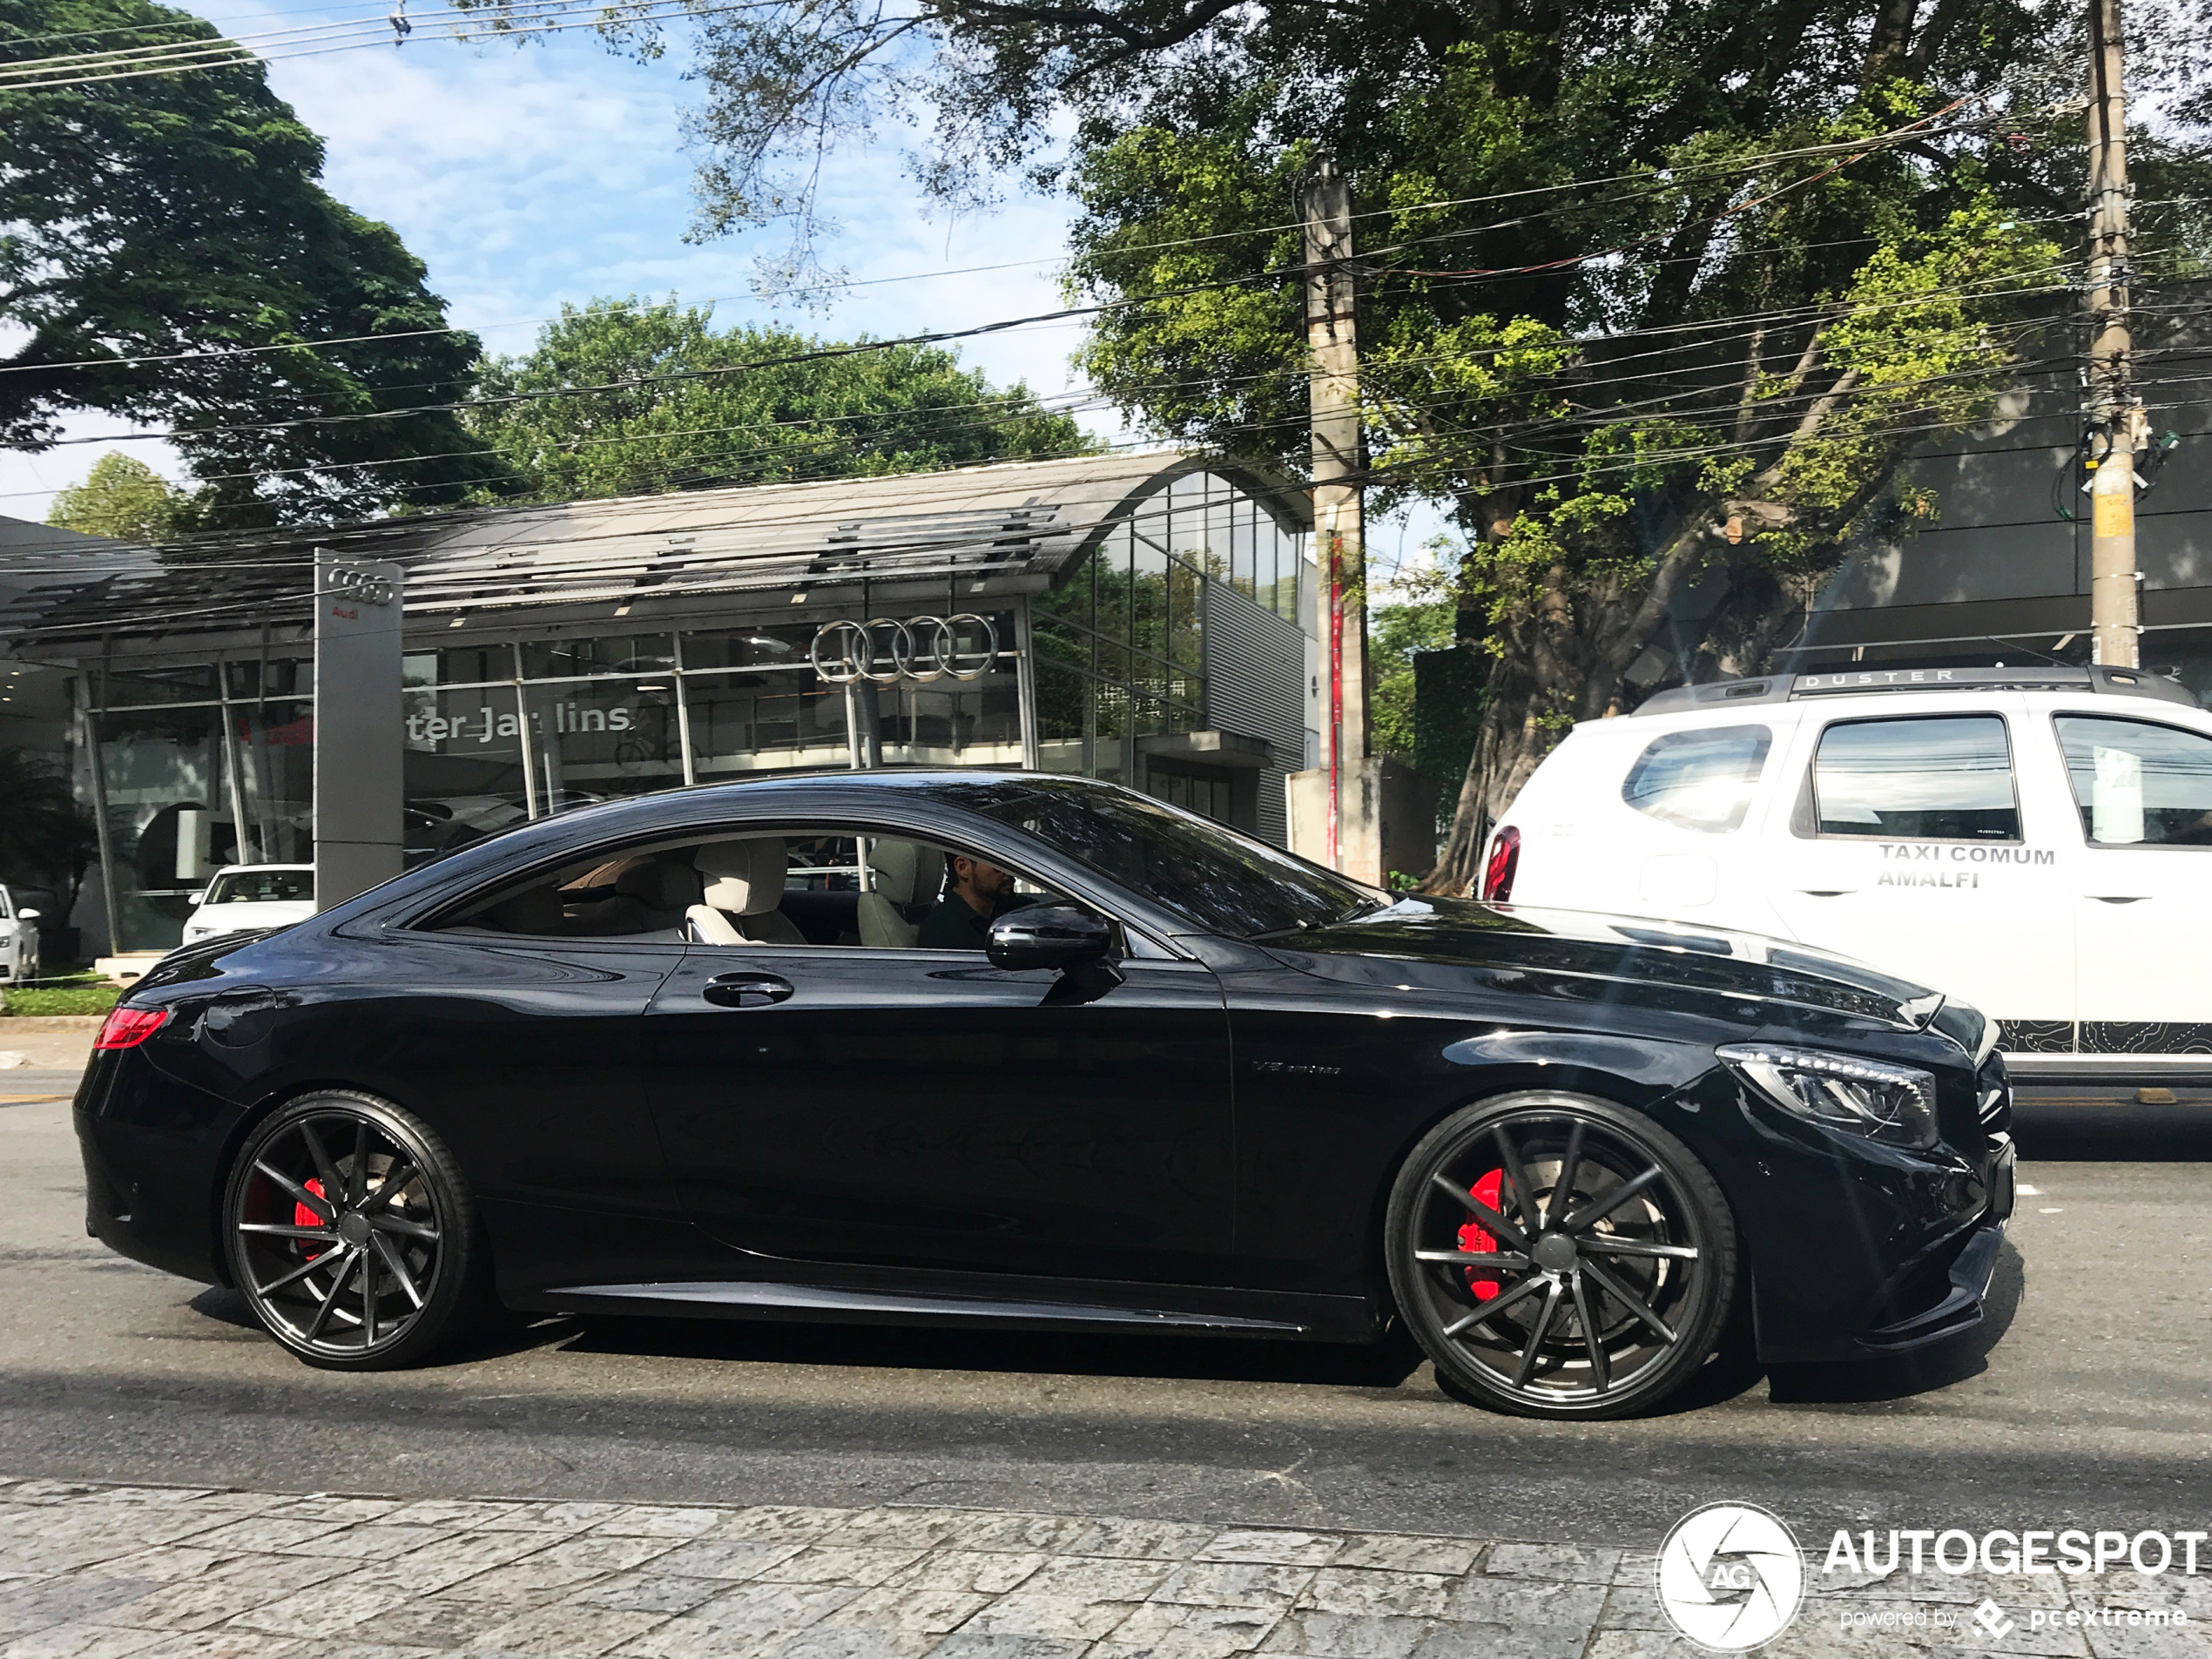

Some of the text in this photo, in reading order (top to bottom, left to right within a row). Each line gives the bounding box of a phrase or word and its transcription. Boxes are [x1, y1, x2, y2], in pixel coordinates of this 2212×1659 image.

[332, 607, 359, 619] Audi
[1805, 670, 1952, 686] DUSTER
[1878, 844, 2054, 865] TAXI COMUM
[1878, 871, 1978, 888] AMALFI
